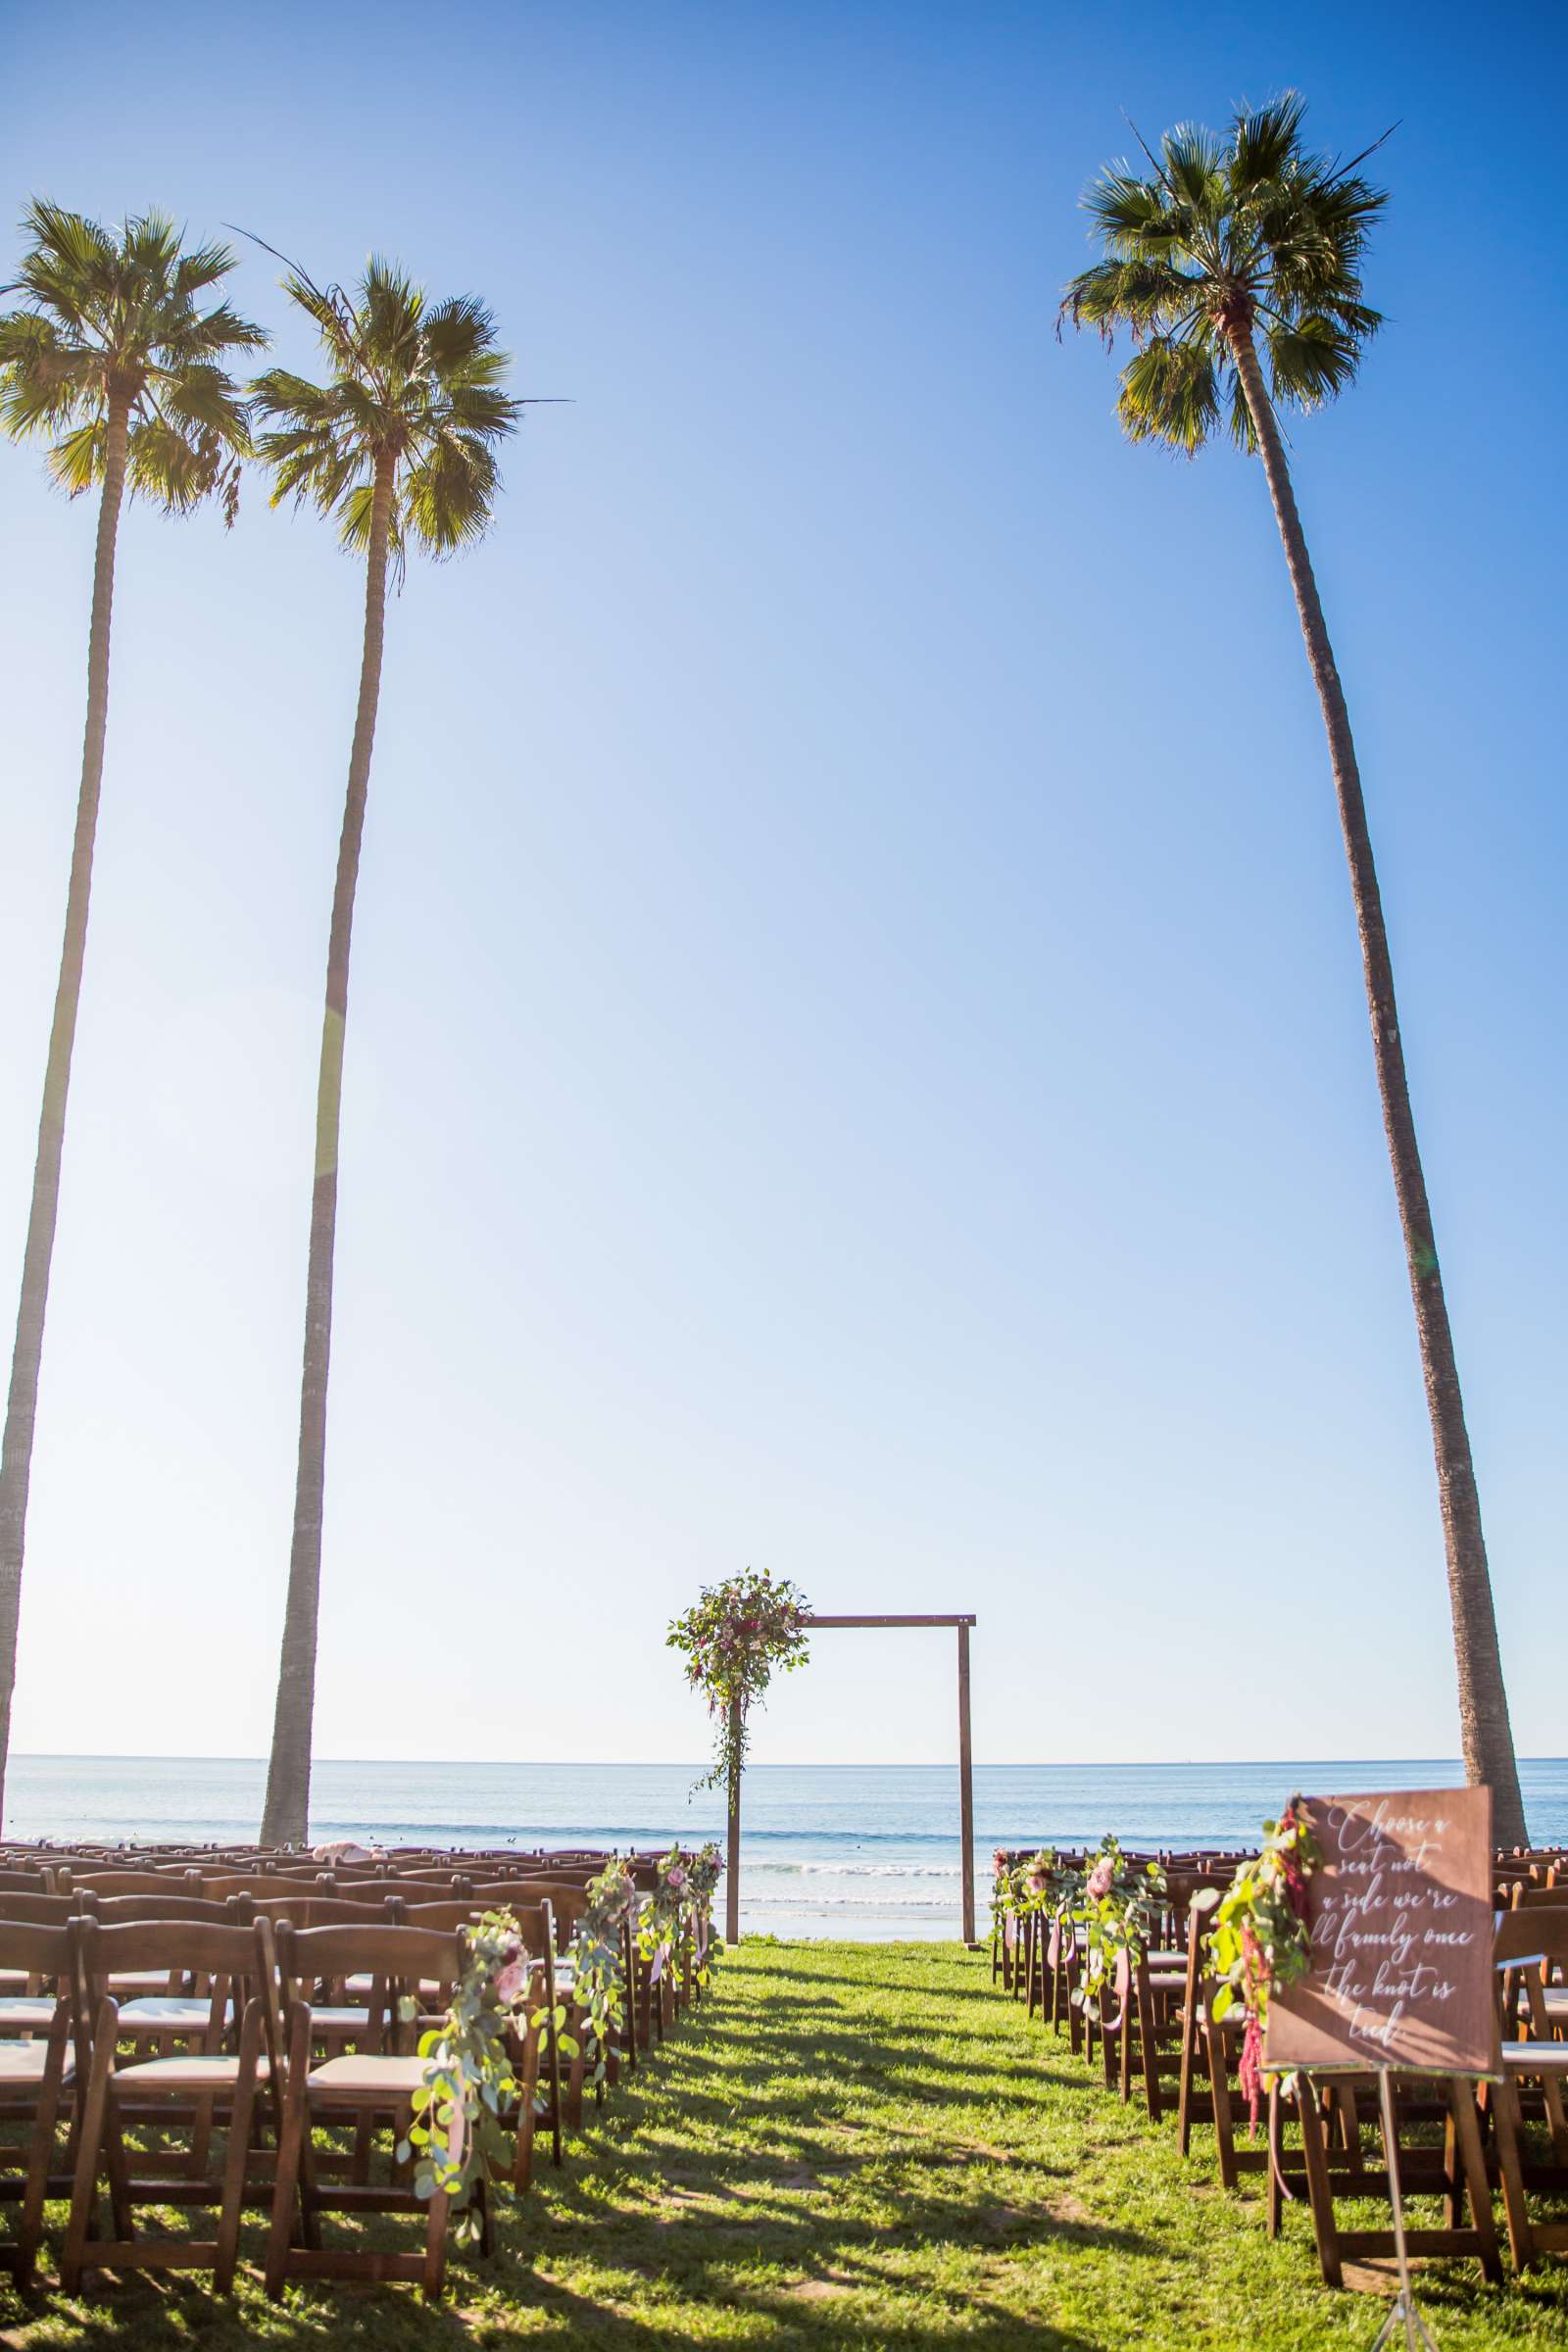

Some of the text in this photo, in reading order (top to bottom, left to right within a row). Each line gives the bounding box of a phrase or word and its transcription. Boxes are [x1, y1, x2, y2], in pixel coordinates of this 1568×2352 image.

[1328, 1800, 1450, 1850] Choose a
[1340, 1841, 1442, 1874] seat not
[1323, 1873, 1458, 1914] a side we're
[1310, 1908, 1474, 1964] ll family once
[1315, 1959, 1455, 2005] the knot is
